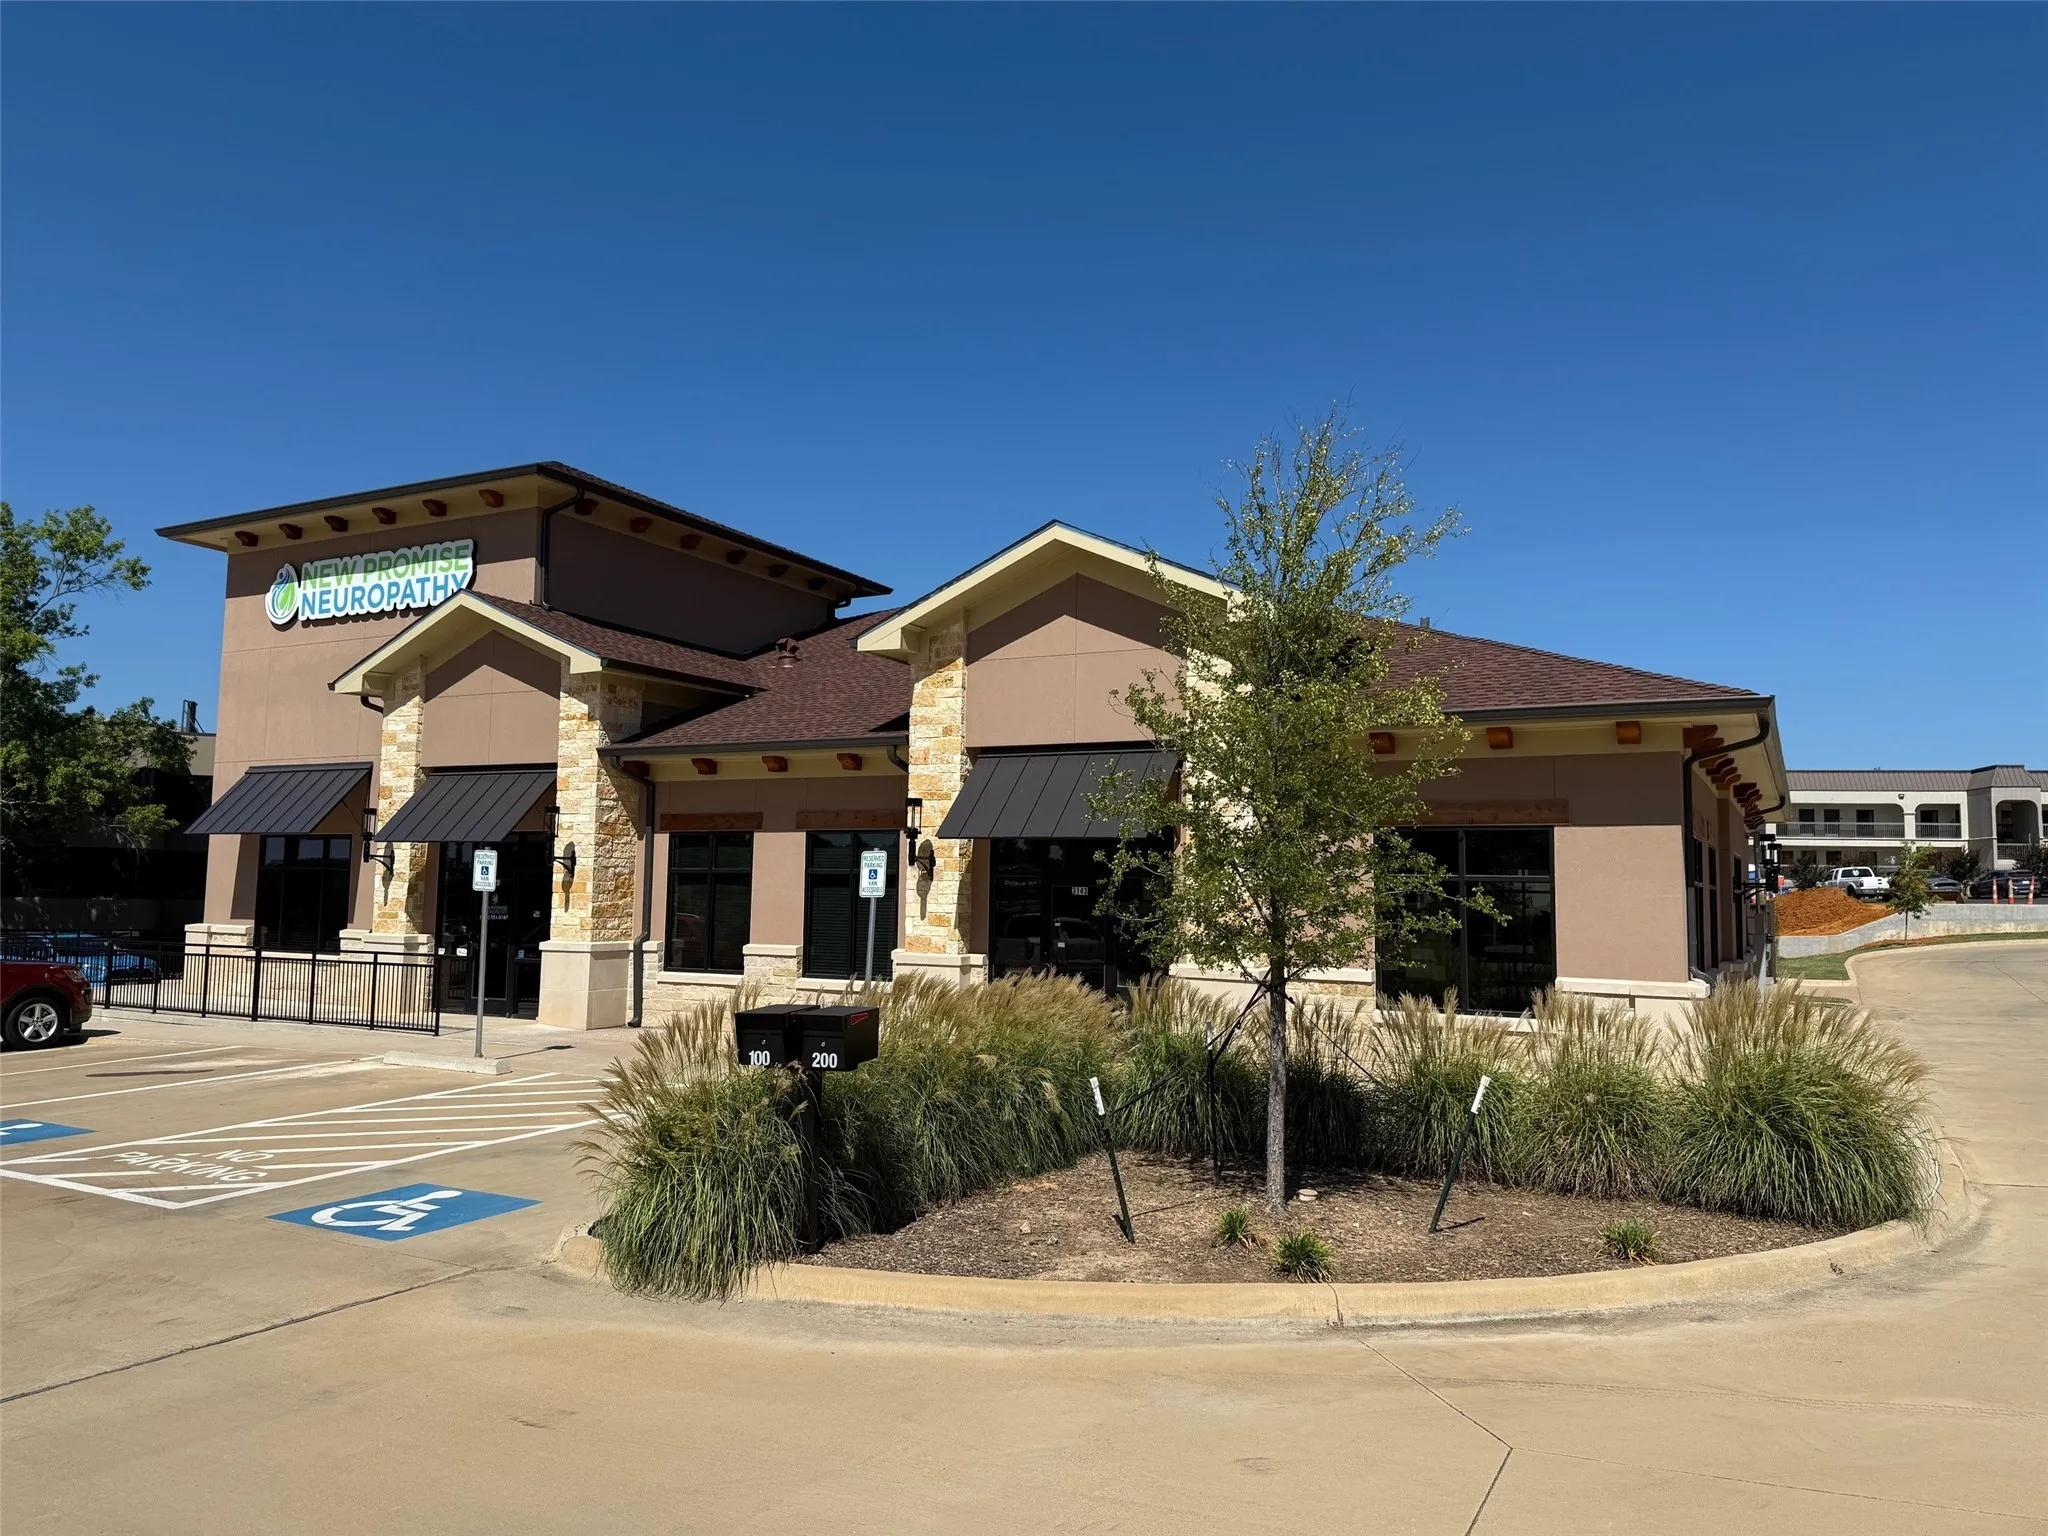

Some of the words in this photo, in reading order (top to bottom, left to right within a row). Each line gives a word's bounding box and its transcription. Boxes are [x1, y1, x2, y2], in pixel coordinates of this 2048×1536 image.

[303, 561, 358, 590] NEW
[363, 544, 470, 583] PROMISE
[301, 572, 469, 616] NEUROPATHY
[748, 1050, 771, 1066] 100
[811, 1052, 838, 1068] 200
[104, 1151, 268, 1181] PARKING
[202, 1149, 274, 1163] NO
